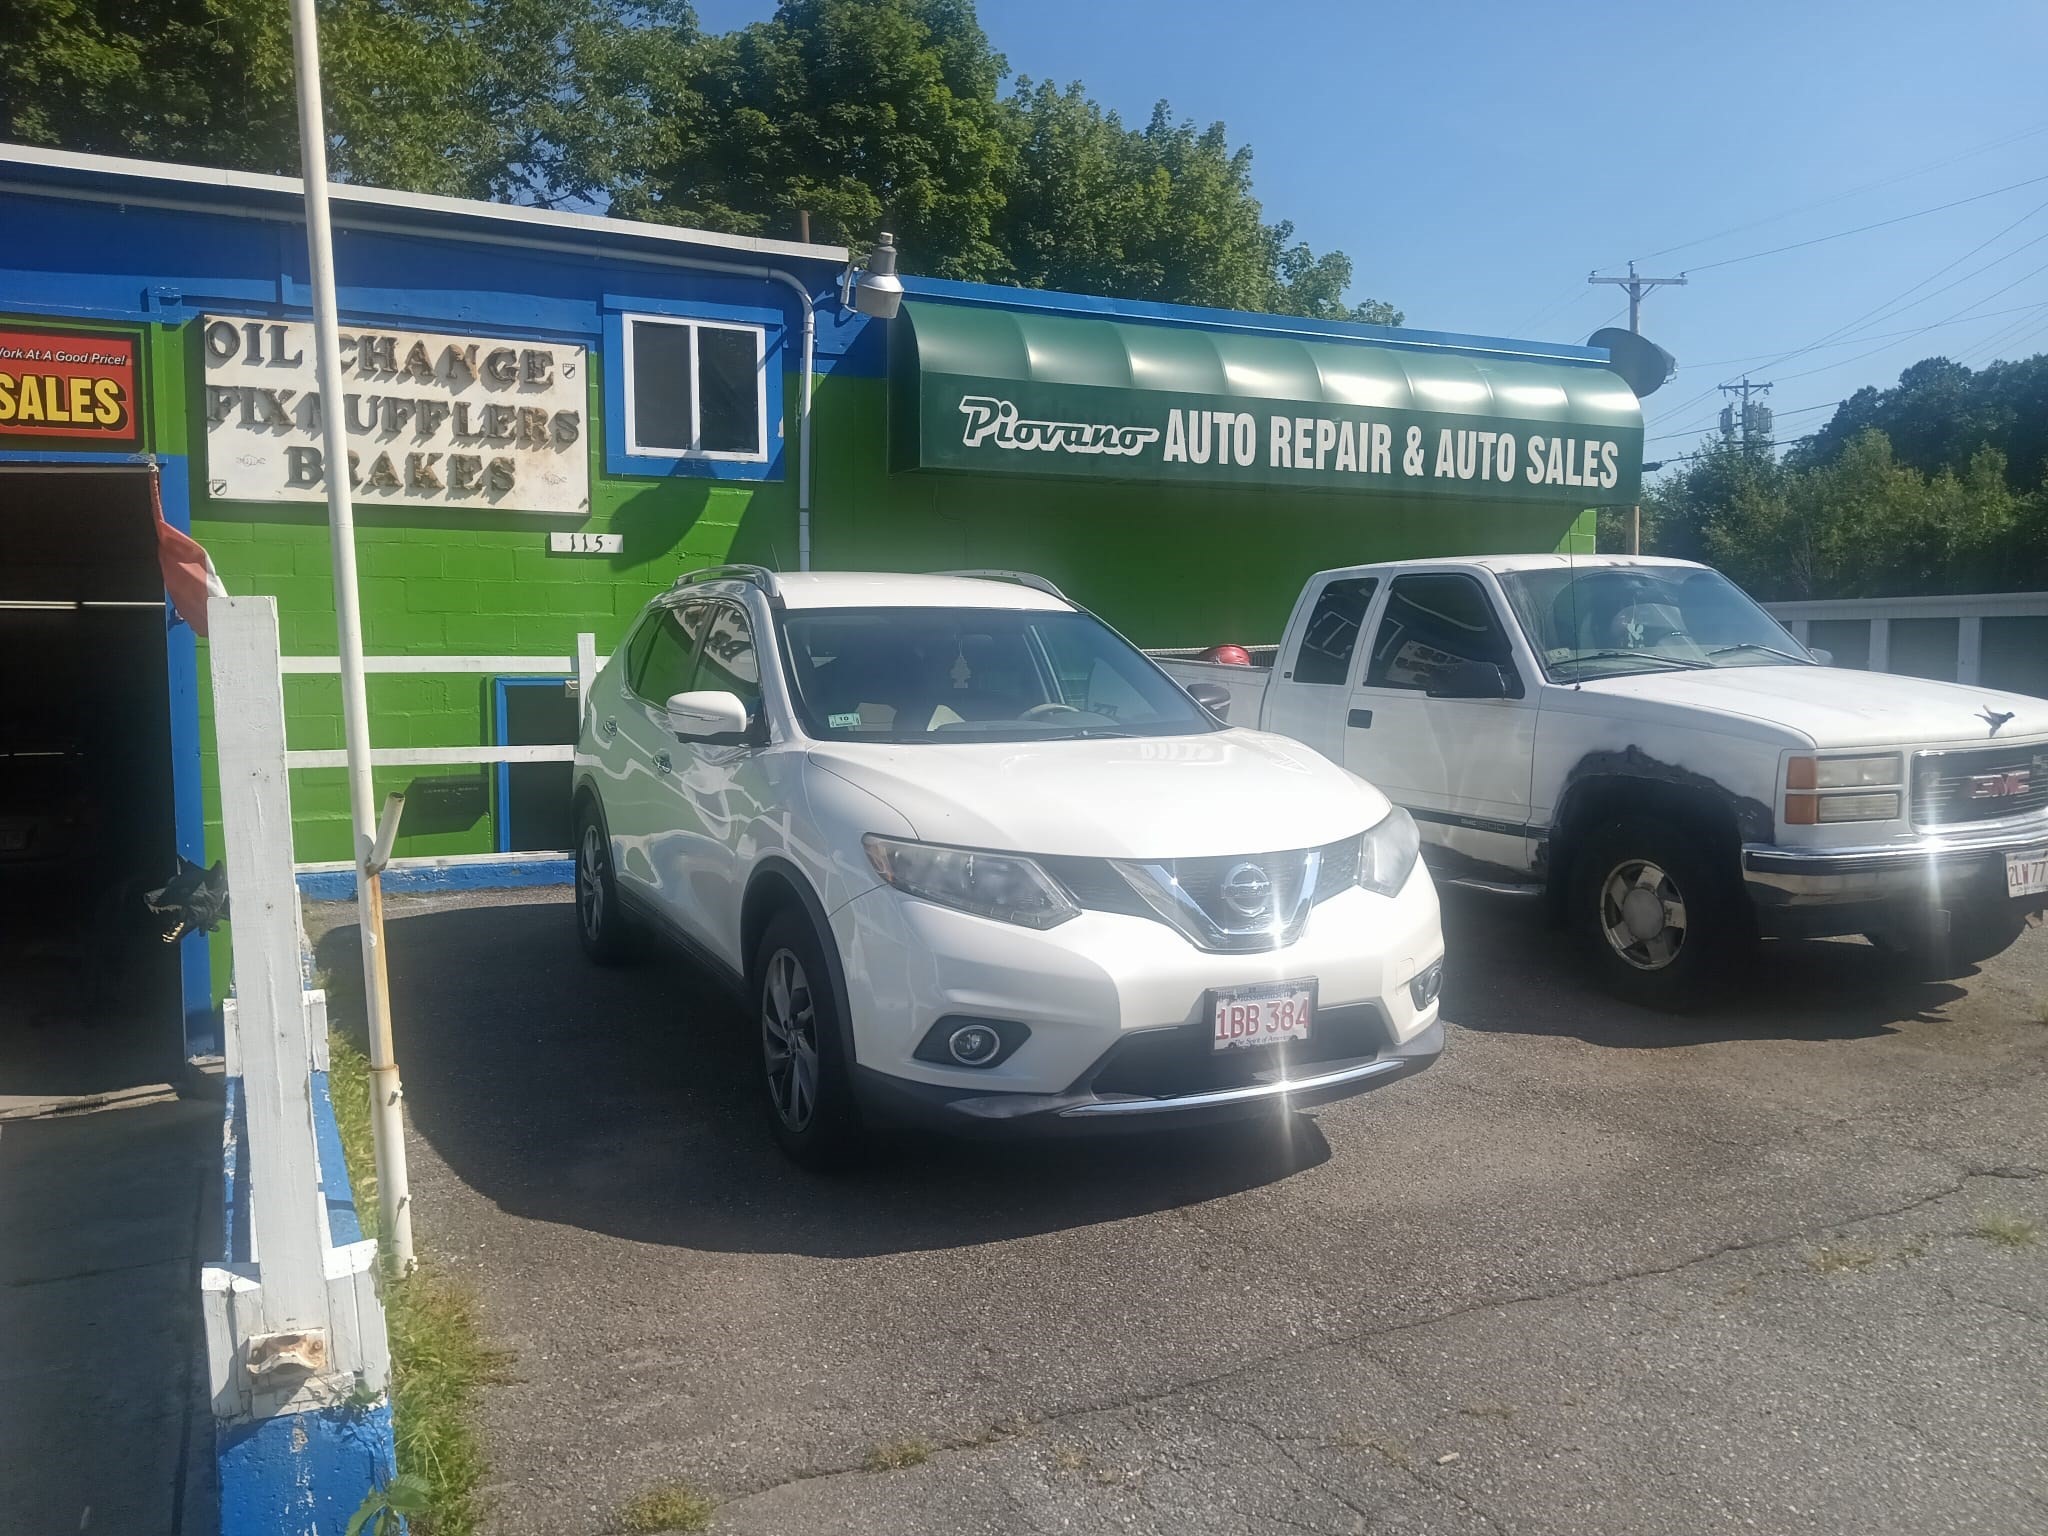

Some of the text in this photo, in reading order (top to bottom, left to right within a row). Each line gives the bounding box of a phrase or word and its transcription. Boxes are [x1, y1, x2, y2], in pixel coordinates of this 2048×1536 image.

[26, 349, 40, 360] At
[43, 350, 52, 361] A
[56, 351, 88, 363] Good
[91, 353, 126, 366] Price!
[206, 321, 303, 364] OIL
[958, 395, 1619, 490] Piovano AUTO REPAIR & AUTO SALES
[570, 533, 603, 553] 115
[1216, 997, 1310, 1040] 1BB 384
